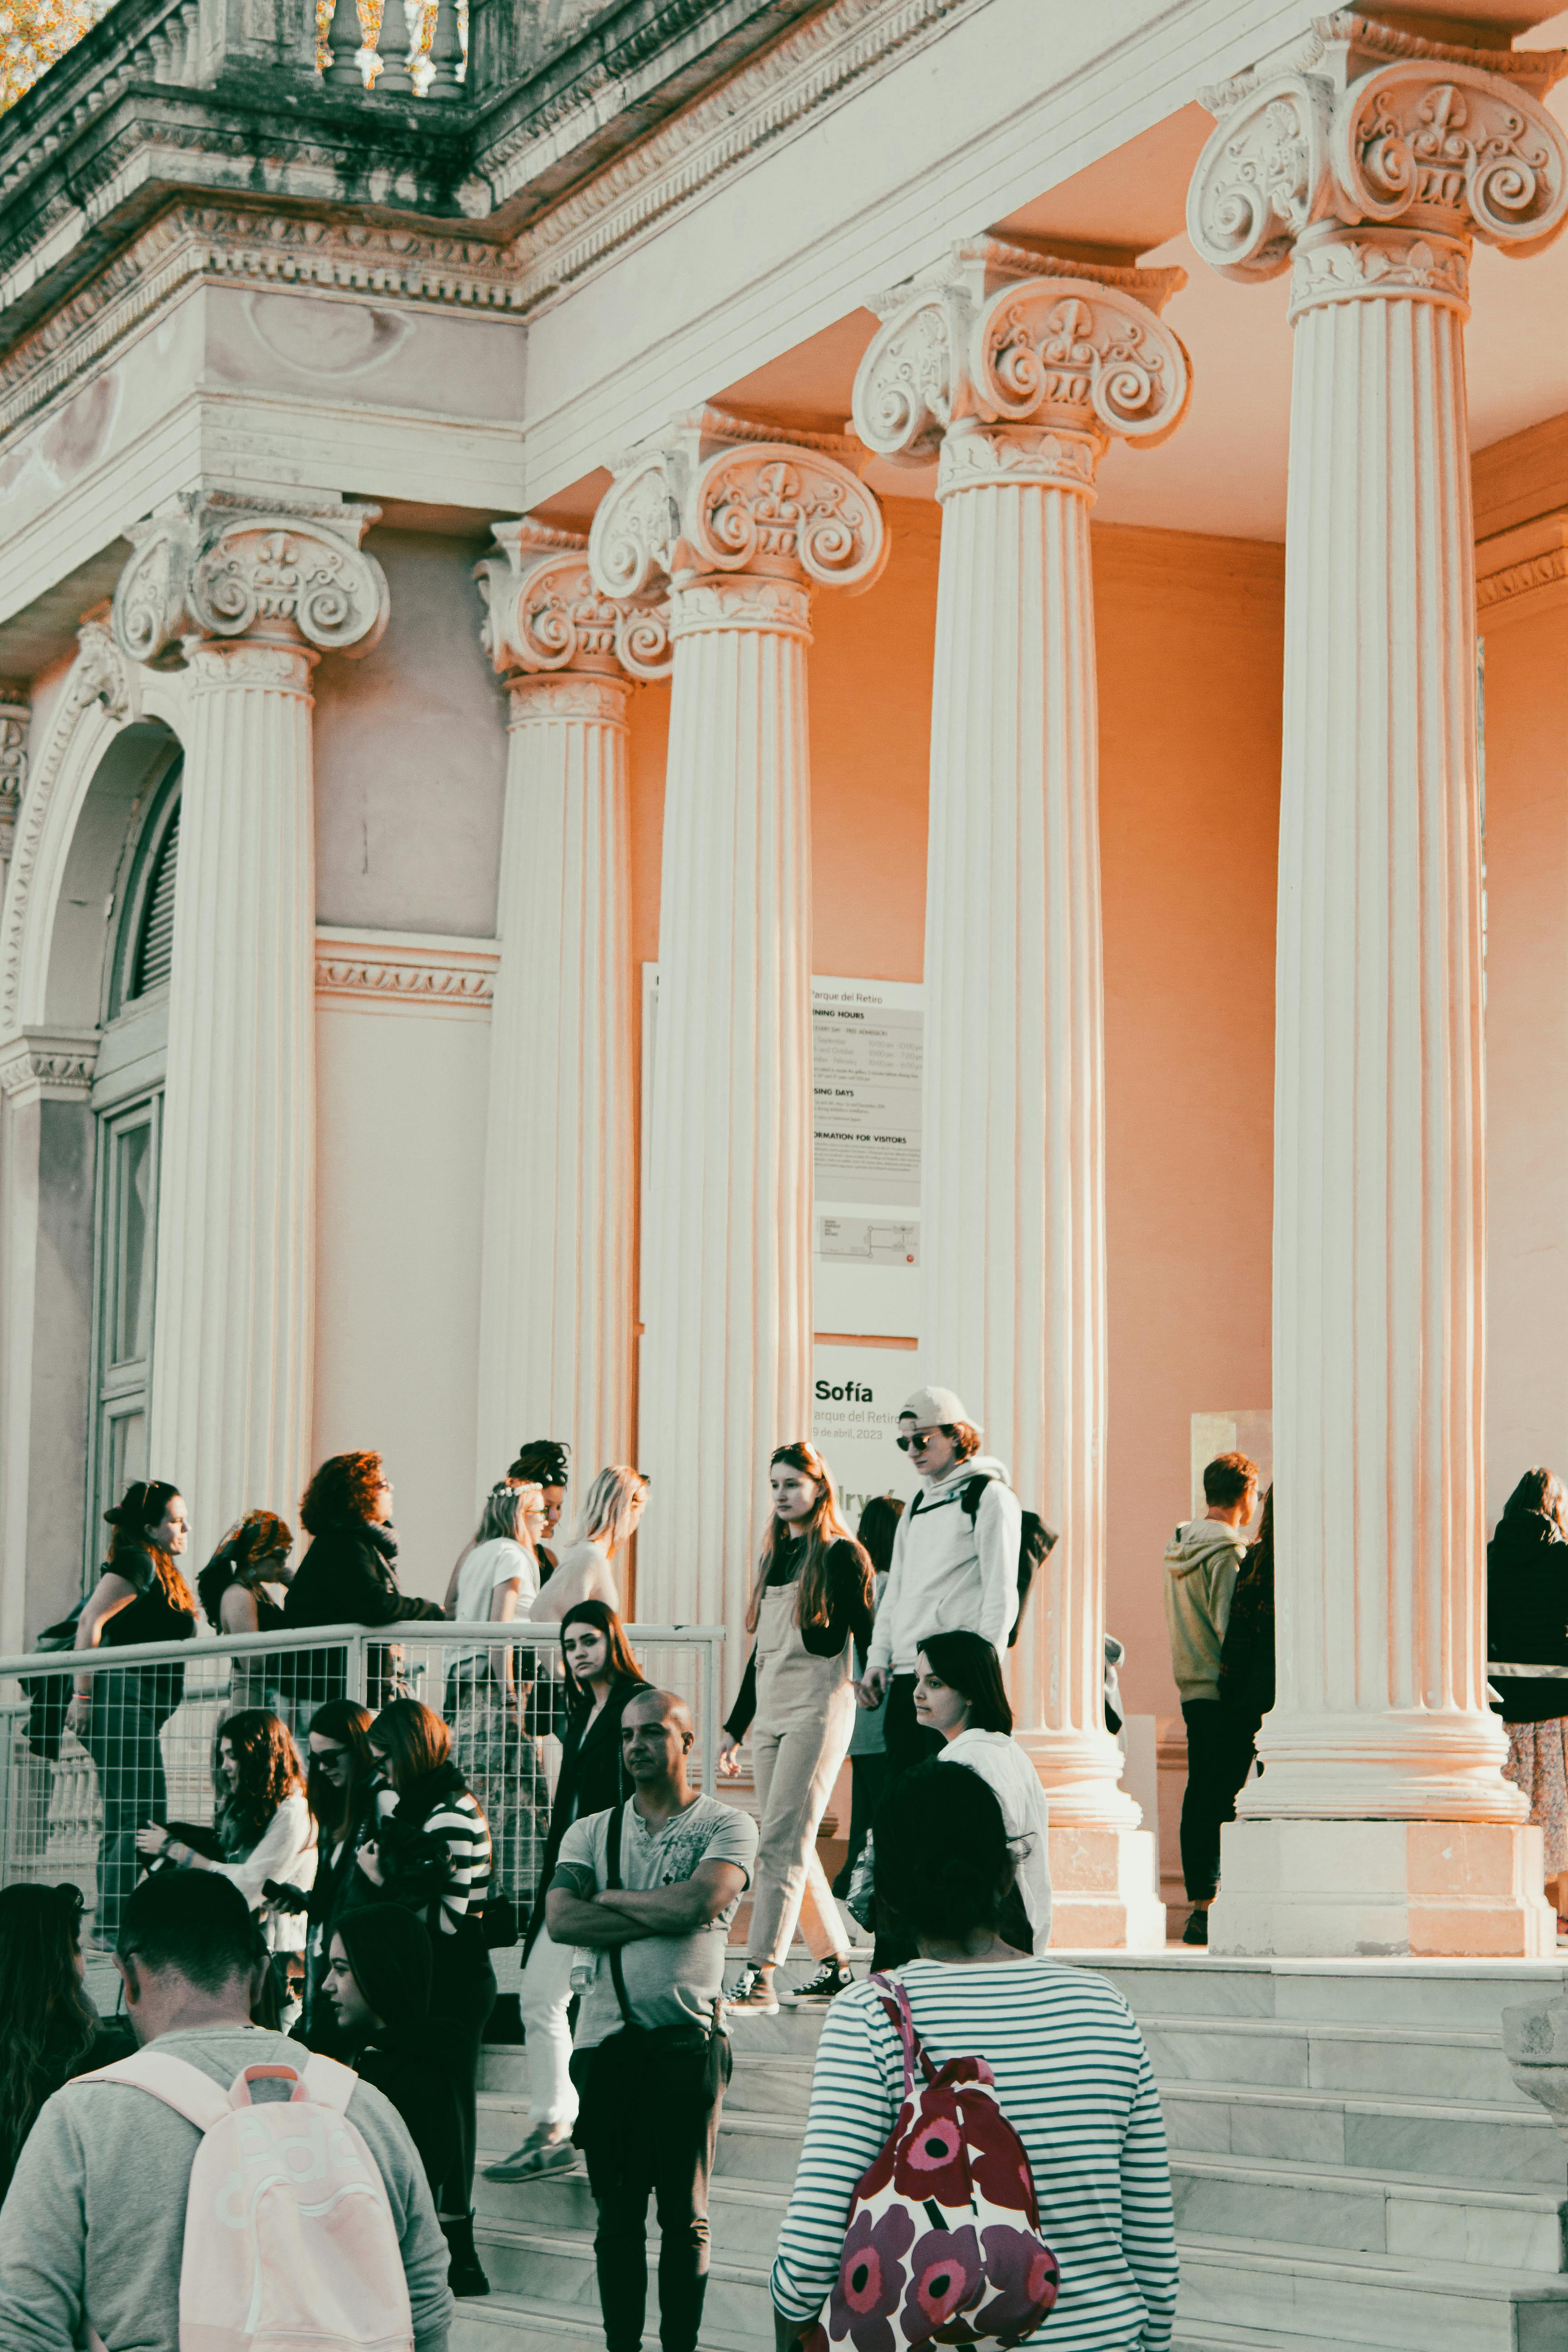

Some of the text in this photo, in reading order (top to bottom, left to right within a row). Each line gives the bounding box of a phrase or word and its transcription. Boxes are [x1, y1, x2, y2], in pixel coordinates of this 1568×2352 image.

[842, 992, 854, 1001] del
[857, 993, 883, 1004] Retiro
[838, 1011, 864, 1019] HOURS
[874, 1136, 906, 1144] VISITORS
[815, 1380, 873, 1402] Sofía
[813, 1410, 845, 1423] arque
[849, 1411, 864, 1422] del
[822, 1428, 831, 1436] de
[857, 1430, 883, 1440] 2023
